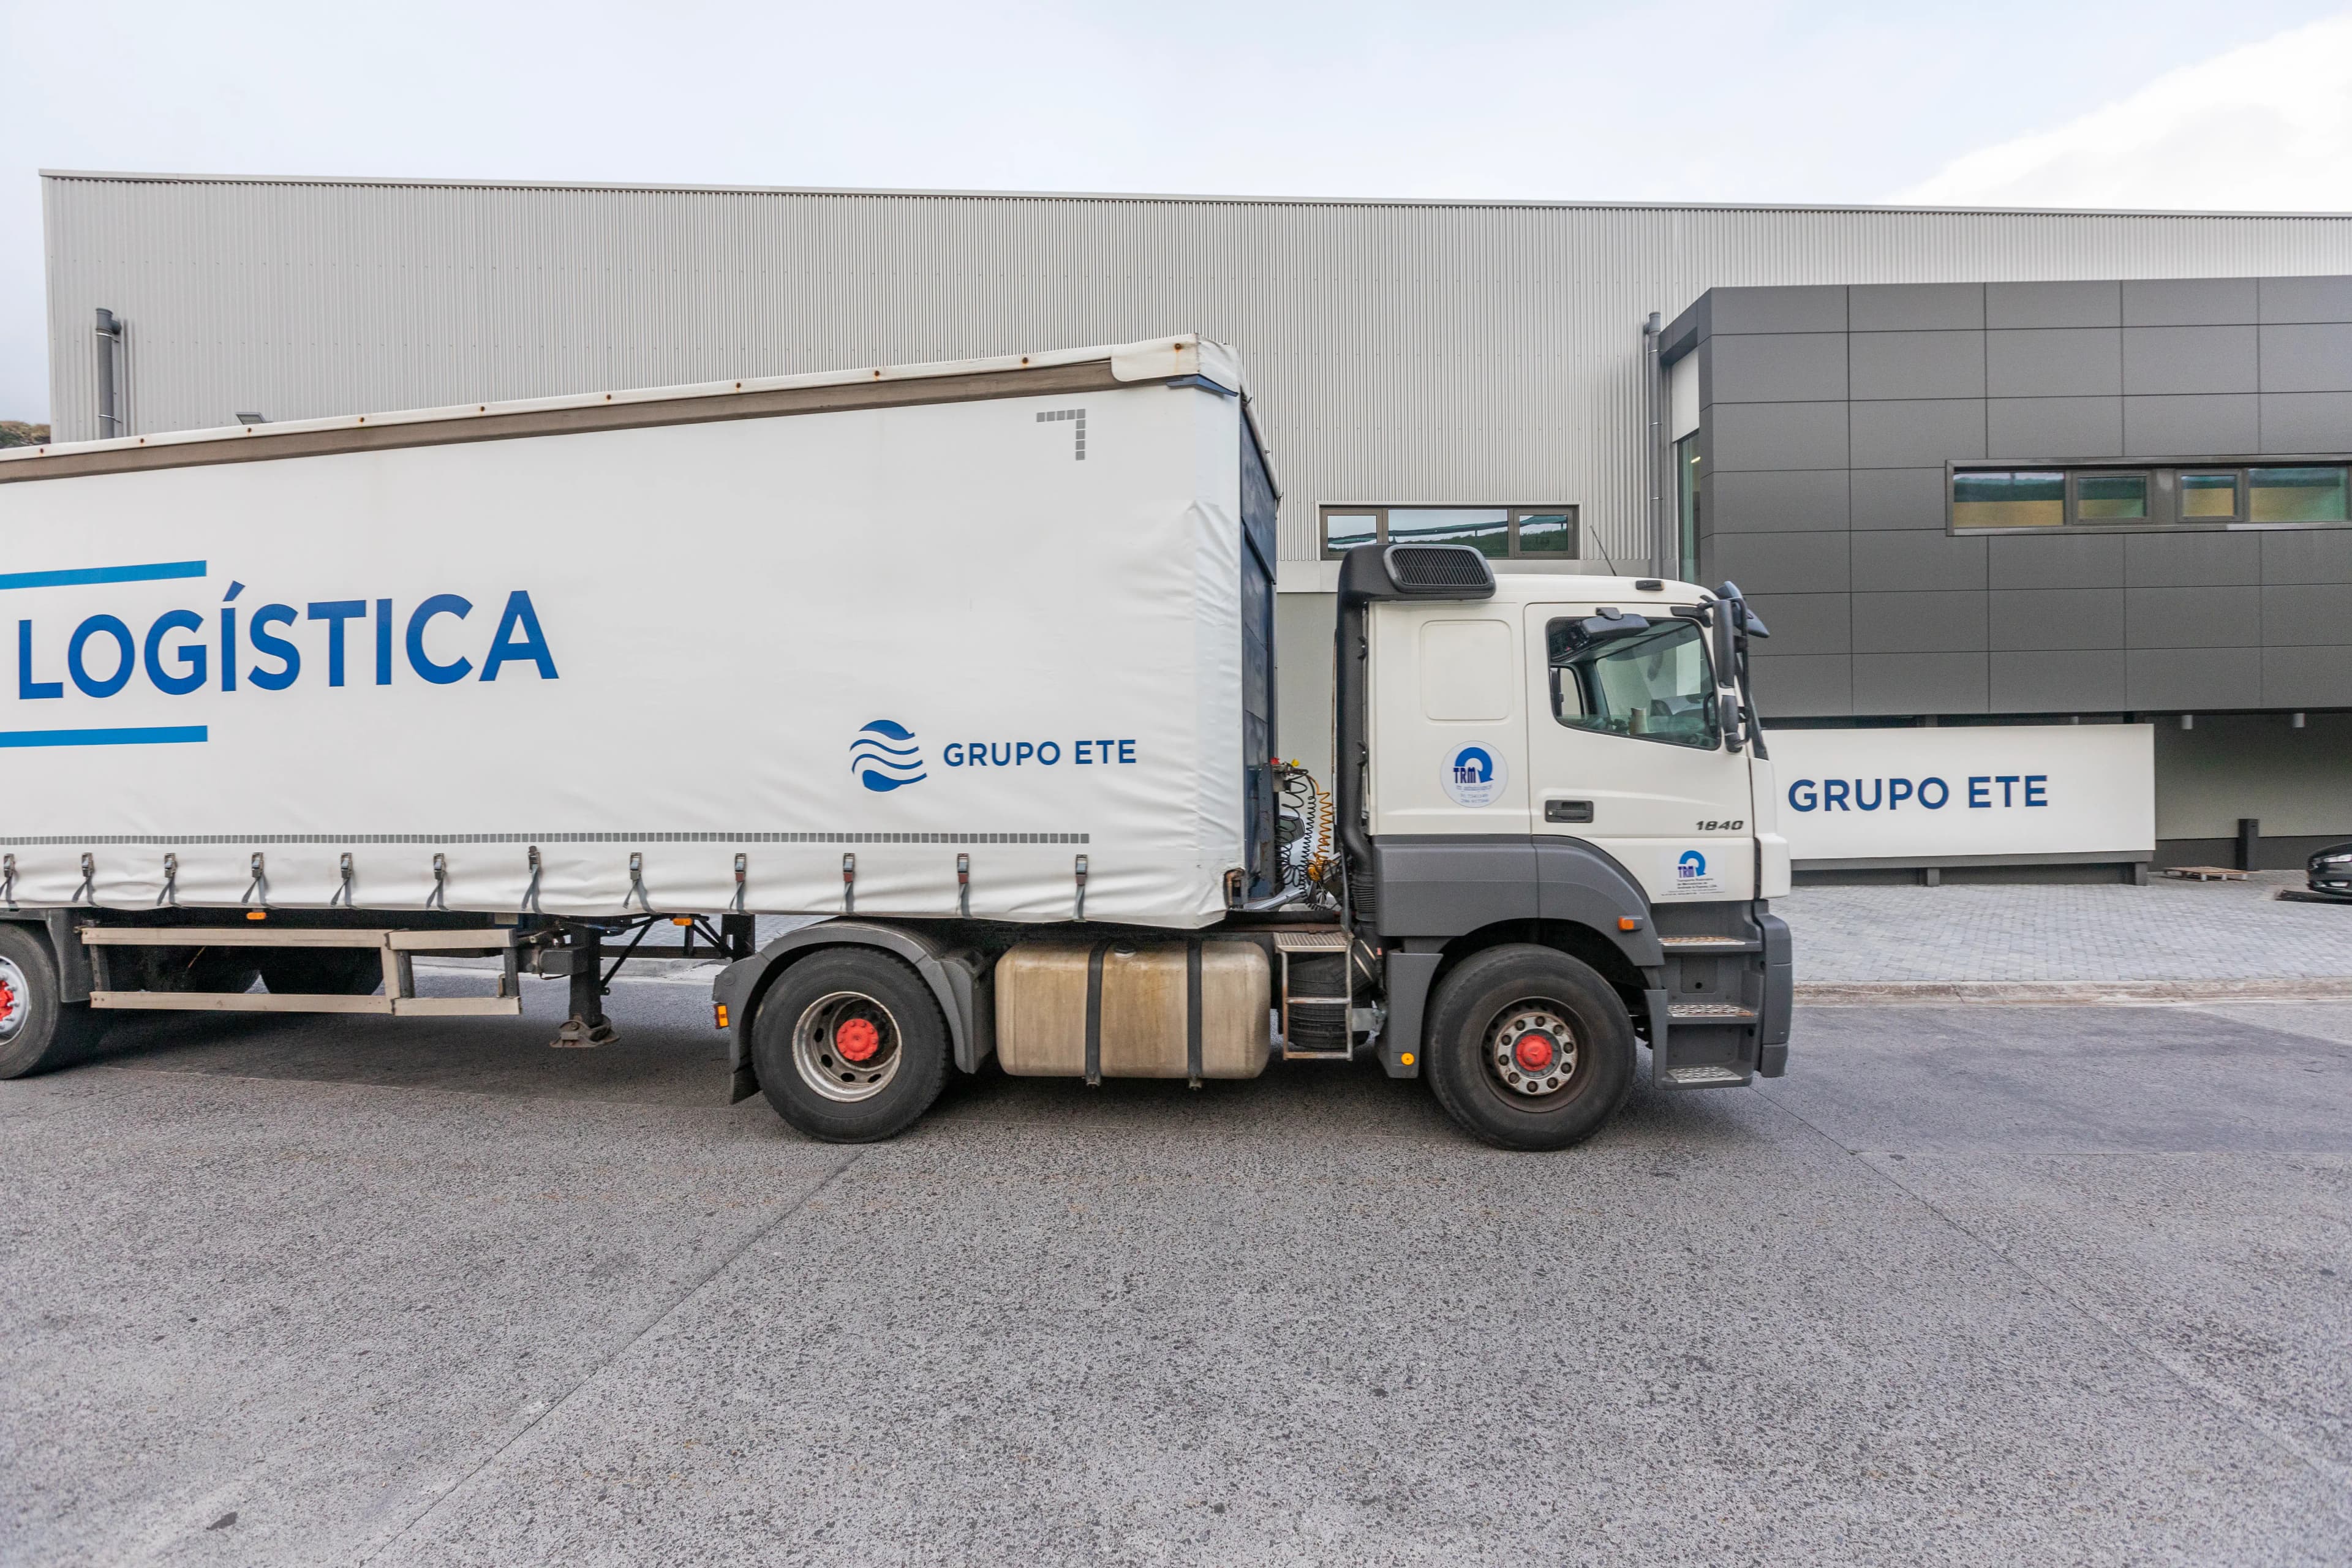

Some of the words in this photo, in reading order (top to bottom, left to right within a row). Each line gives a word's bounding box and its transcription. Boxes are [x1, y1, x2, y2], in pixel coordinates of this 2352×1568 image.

[18, 580, 559, 700] LOGÍSTICA
[943, 741, 1061, 767] GRUPO
[1075, 739, 1136, 765] ETE
[1453, 767, 1476, 783] TRM
[1789, 777, 1949, 812] GRUPO
[1969, 775, 2047, 808] ETE
[1695, 820, 1744, 831] 1840
